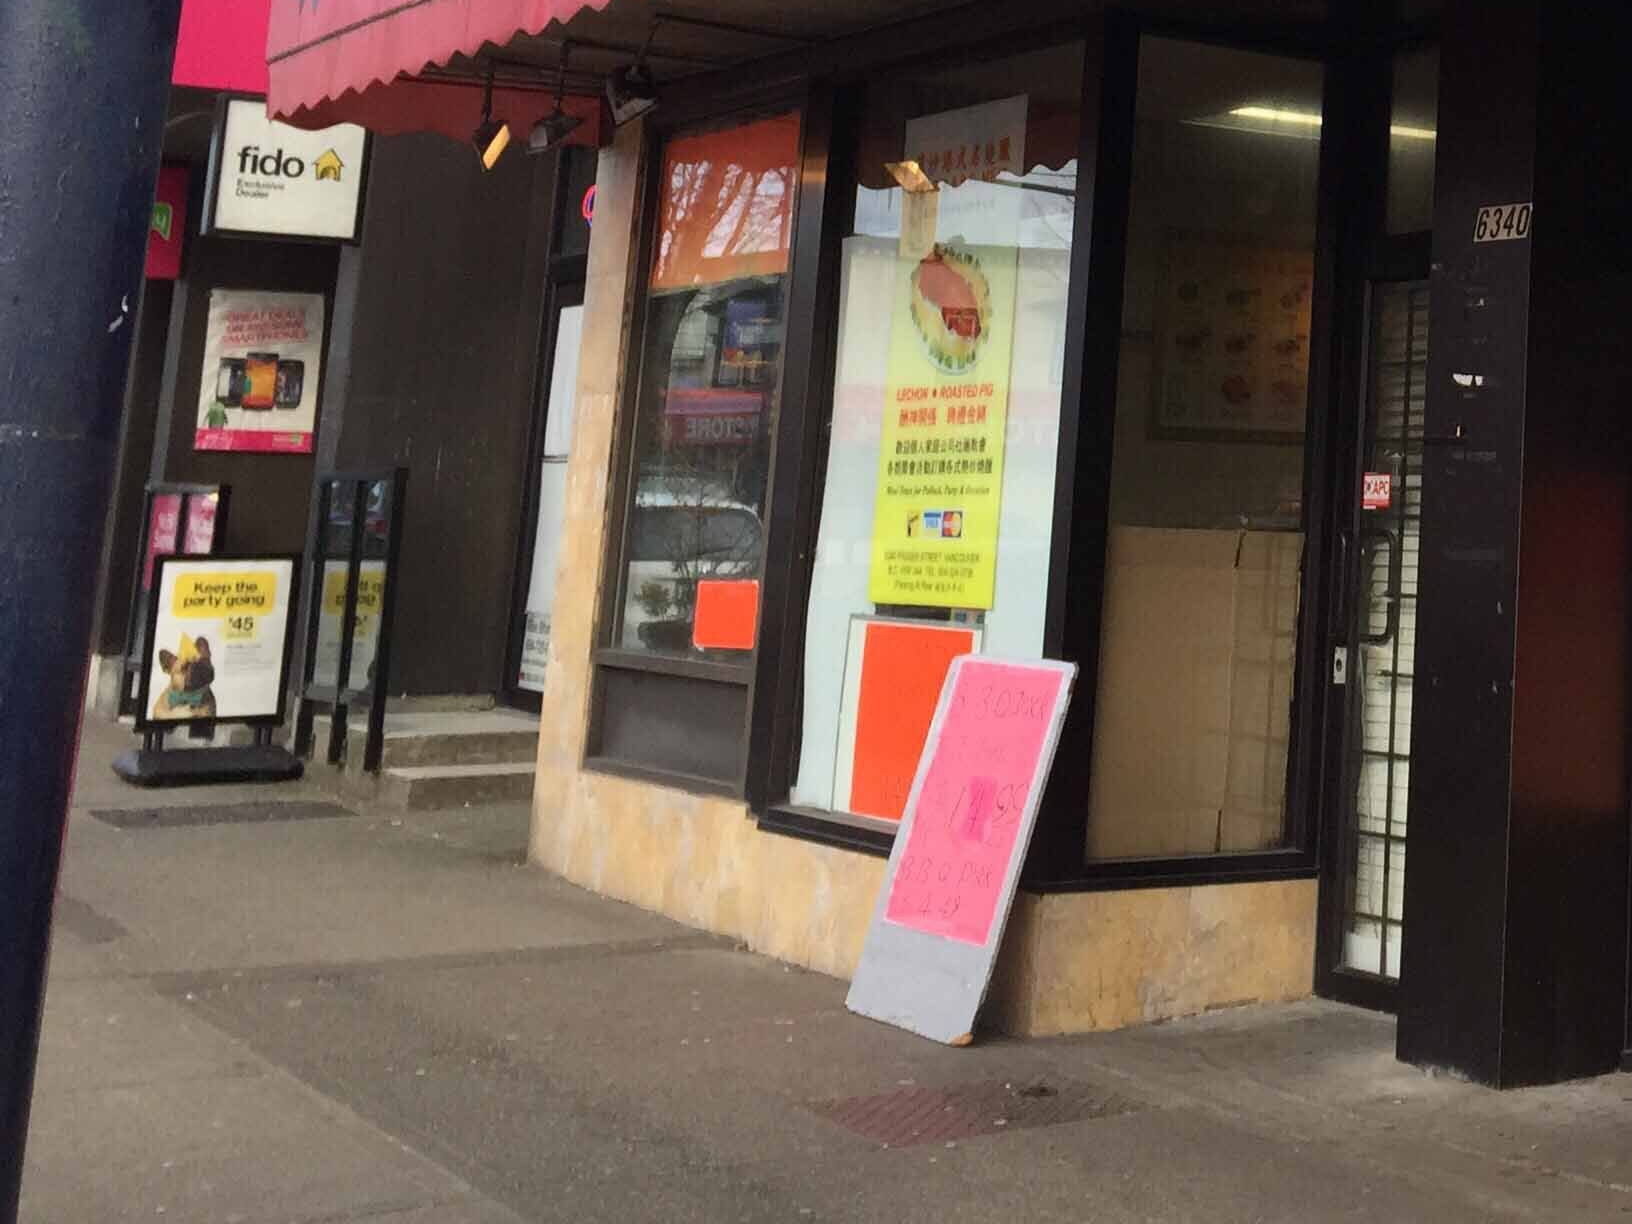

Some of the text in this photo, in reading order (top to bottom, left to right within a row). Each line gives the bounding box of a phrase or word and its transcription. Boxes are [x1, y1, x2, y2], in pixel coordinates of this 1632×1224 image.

[238, 145, 305, 178] fido
[1475, 205, 1531, 241] 6340
[194, 581, 258, 595] Keep the
[183, 594, 266, 608] party going
